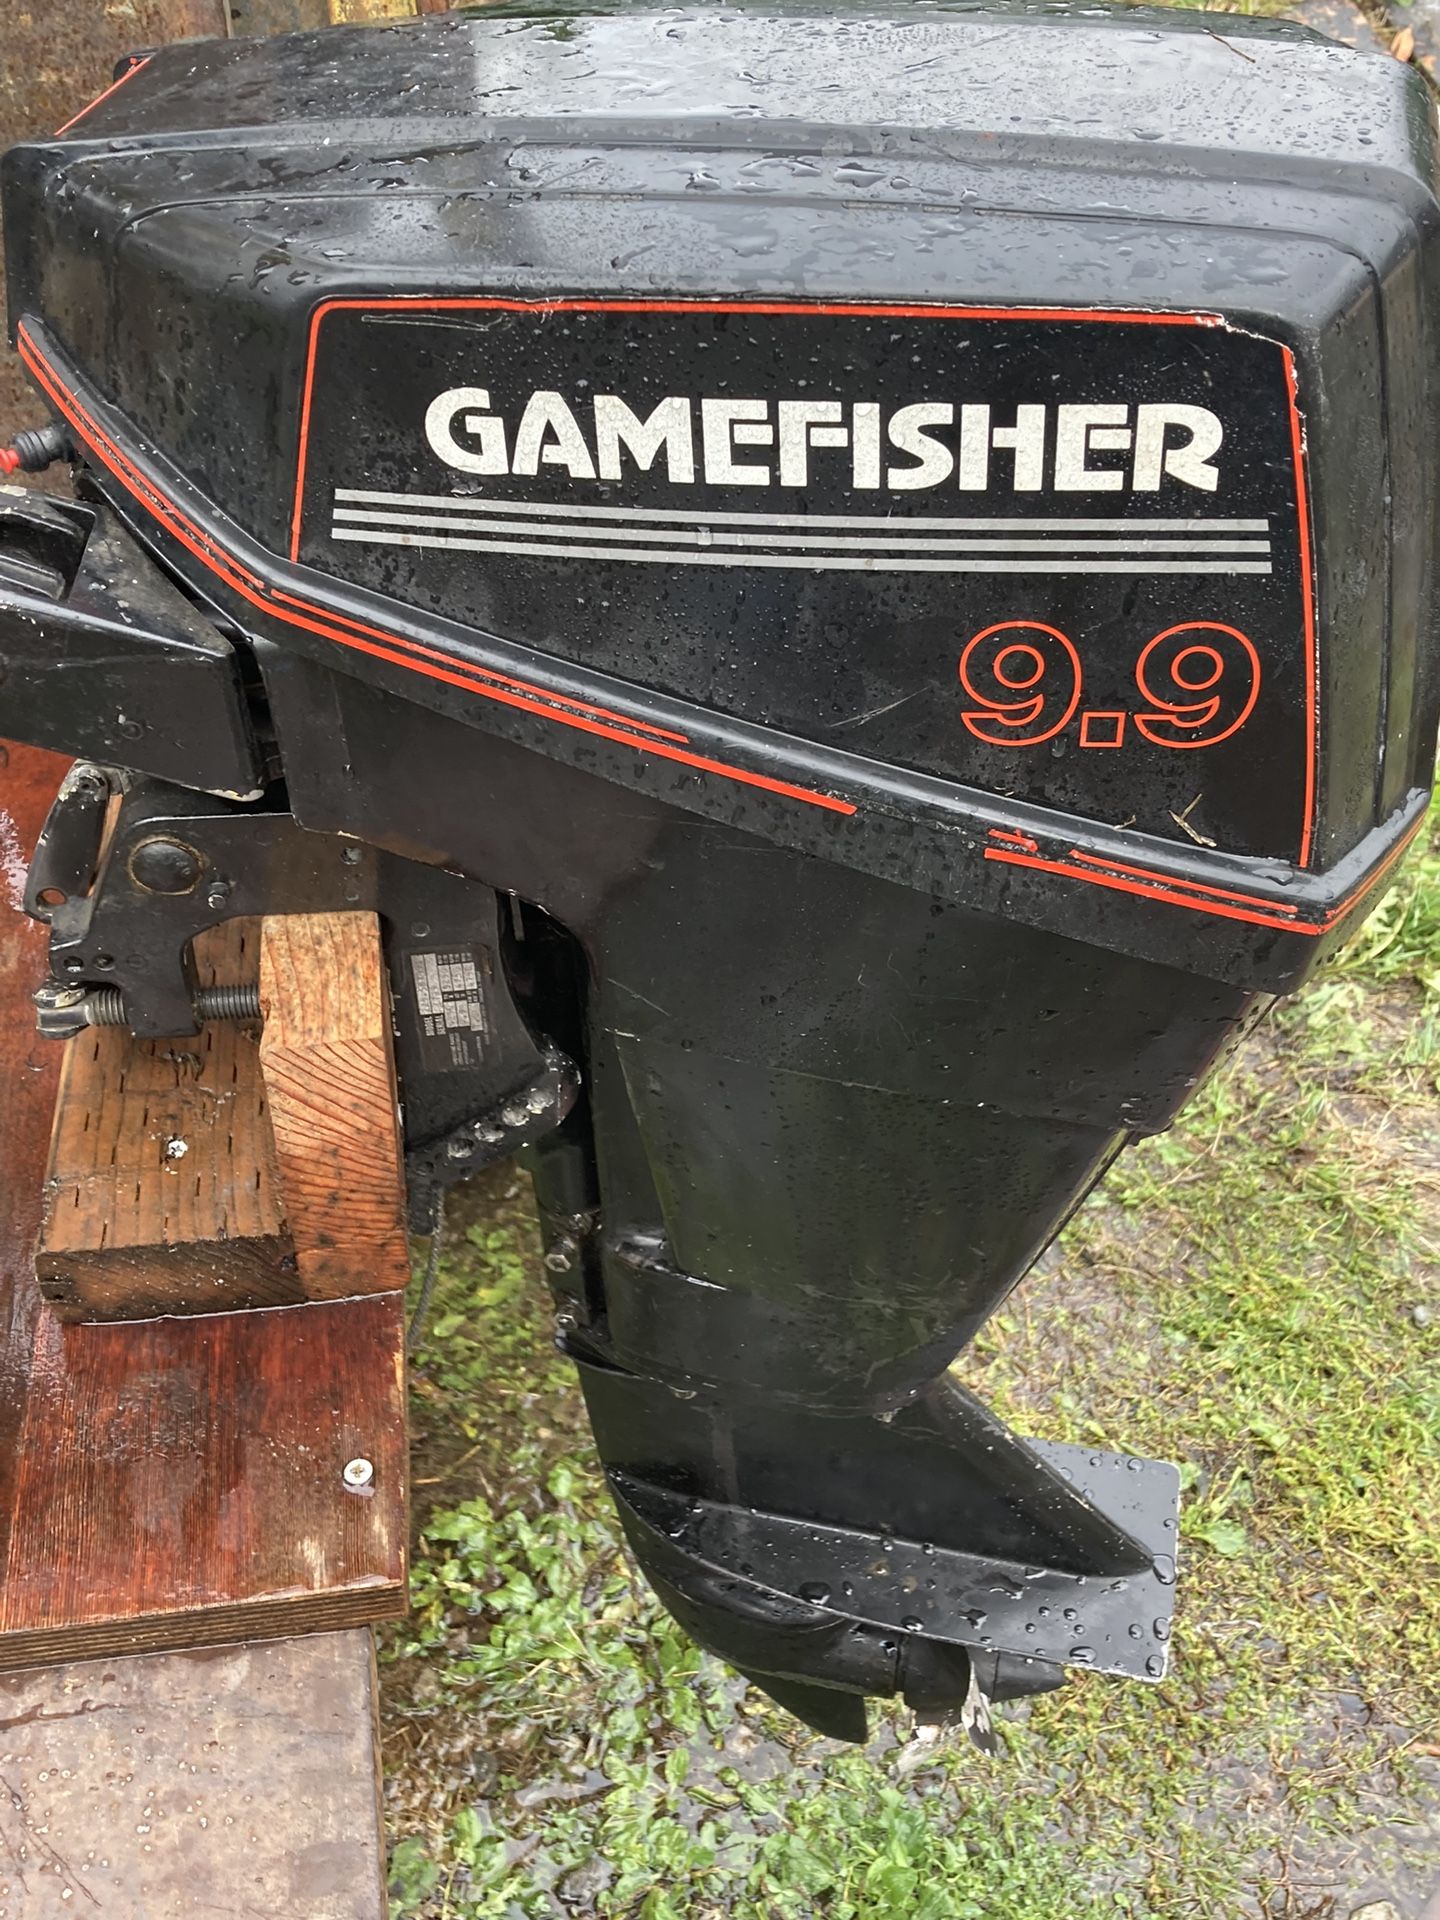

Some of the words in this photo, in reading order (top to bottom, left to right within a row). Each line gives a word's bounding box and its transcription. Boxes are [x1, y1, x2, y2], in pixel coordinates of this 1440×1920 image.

[424, 386, 1224, 492] GAMEFISHER
[958, 620, 1261, 748] 9.9
[424, 1016, 436, 1036] MODEL
